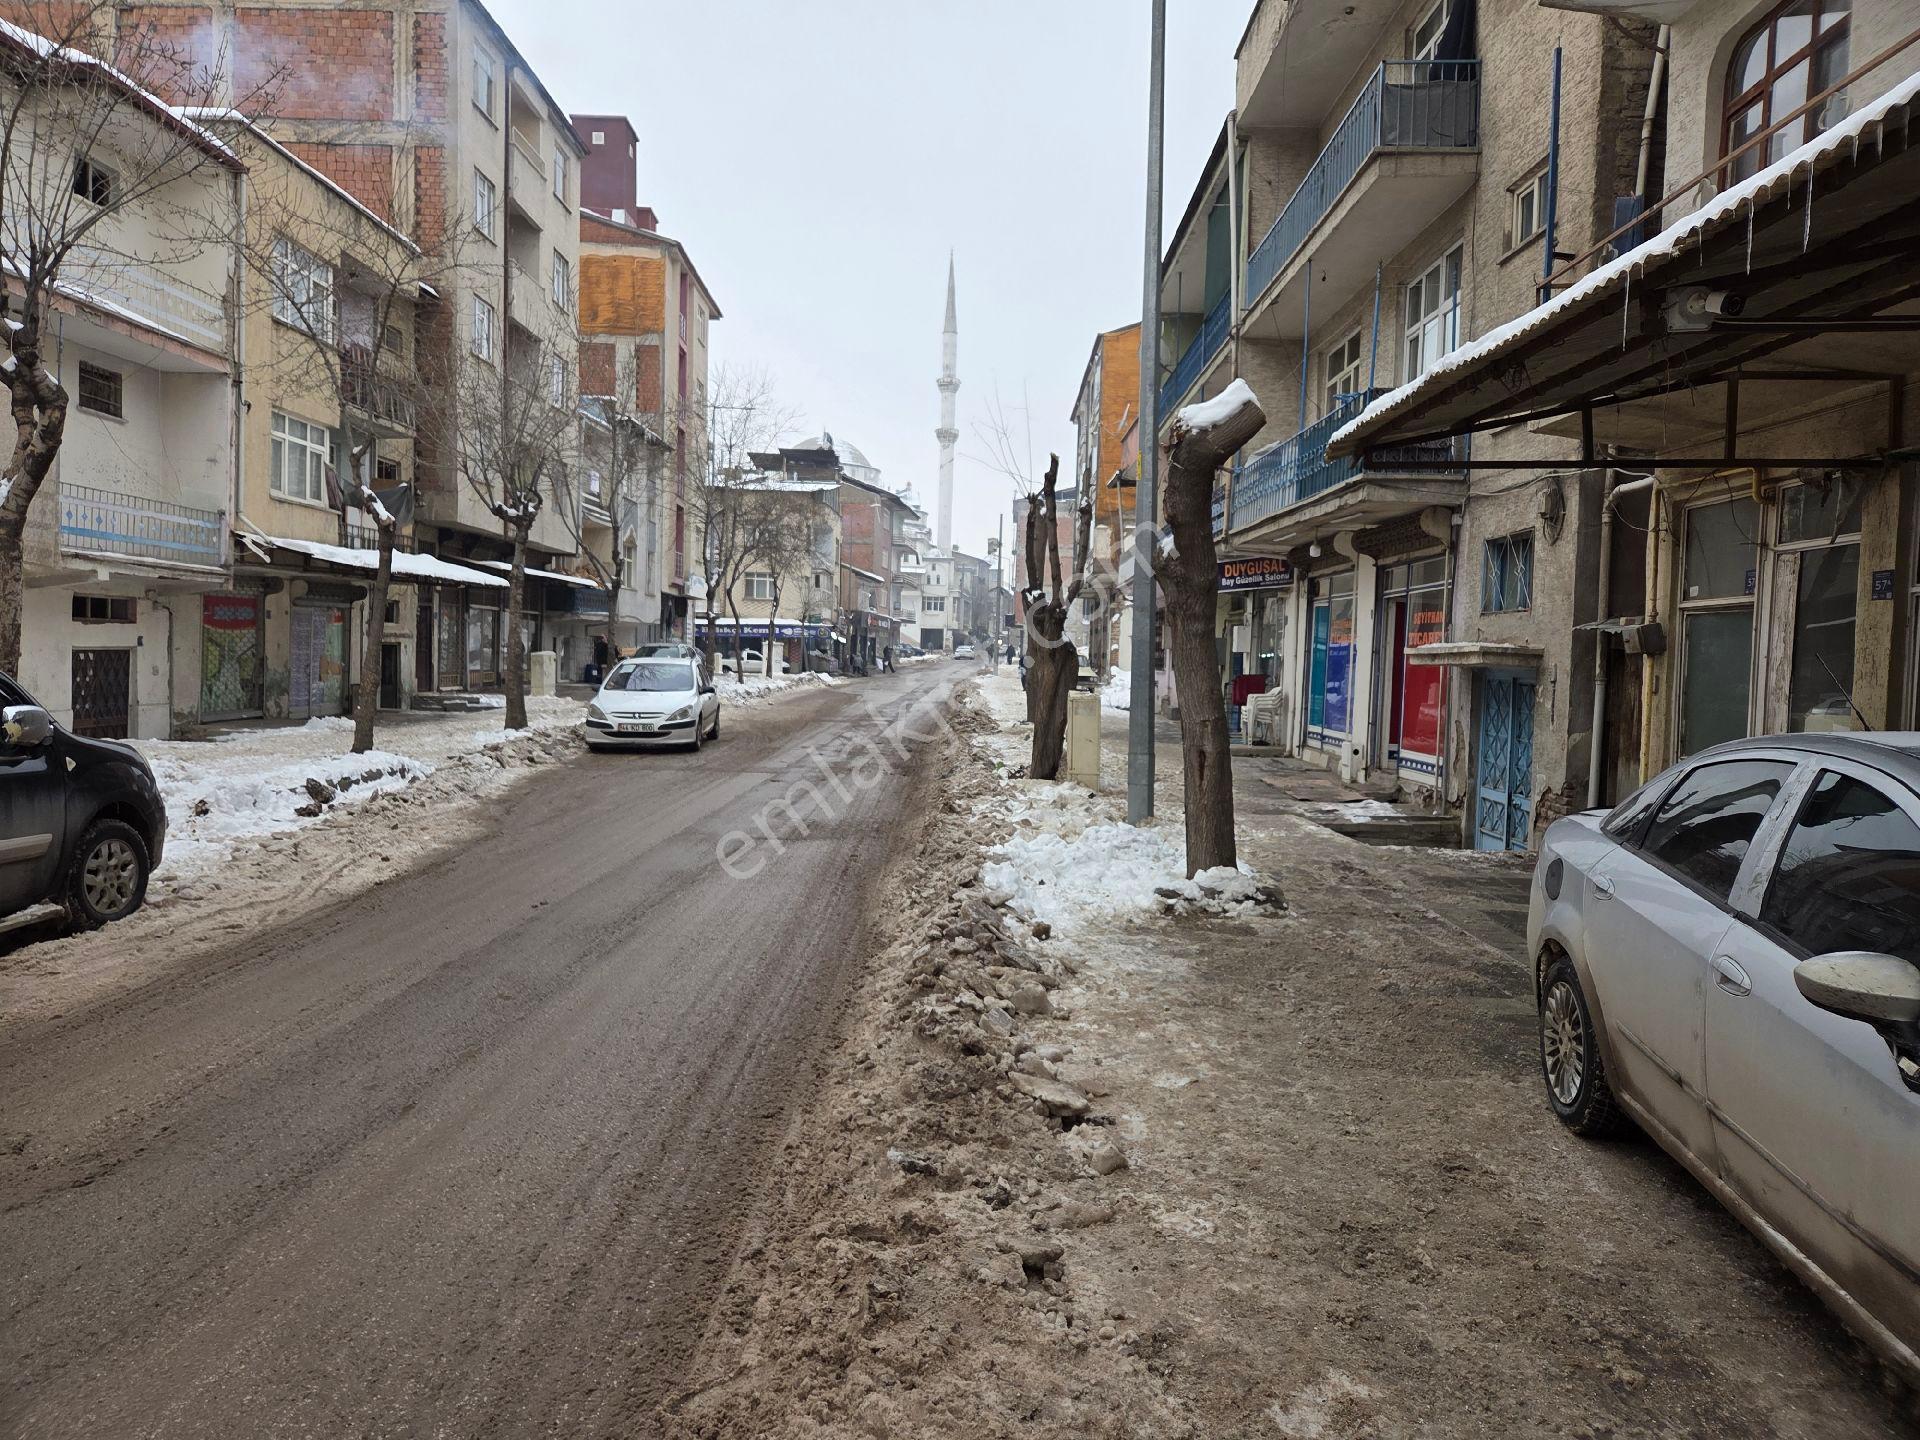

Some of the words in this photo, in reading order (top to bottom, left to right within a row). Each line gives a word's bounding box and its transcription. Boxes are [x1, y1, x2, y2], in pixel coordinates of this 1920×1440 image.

[1224, 559, 1285, 578] DUYGUSAL
[1221, 577, 1235, 587] Bay
[743, 626, 780, 635] Keml
